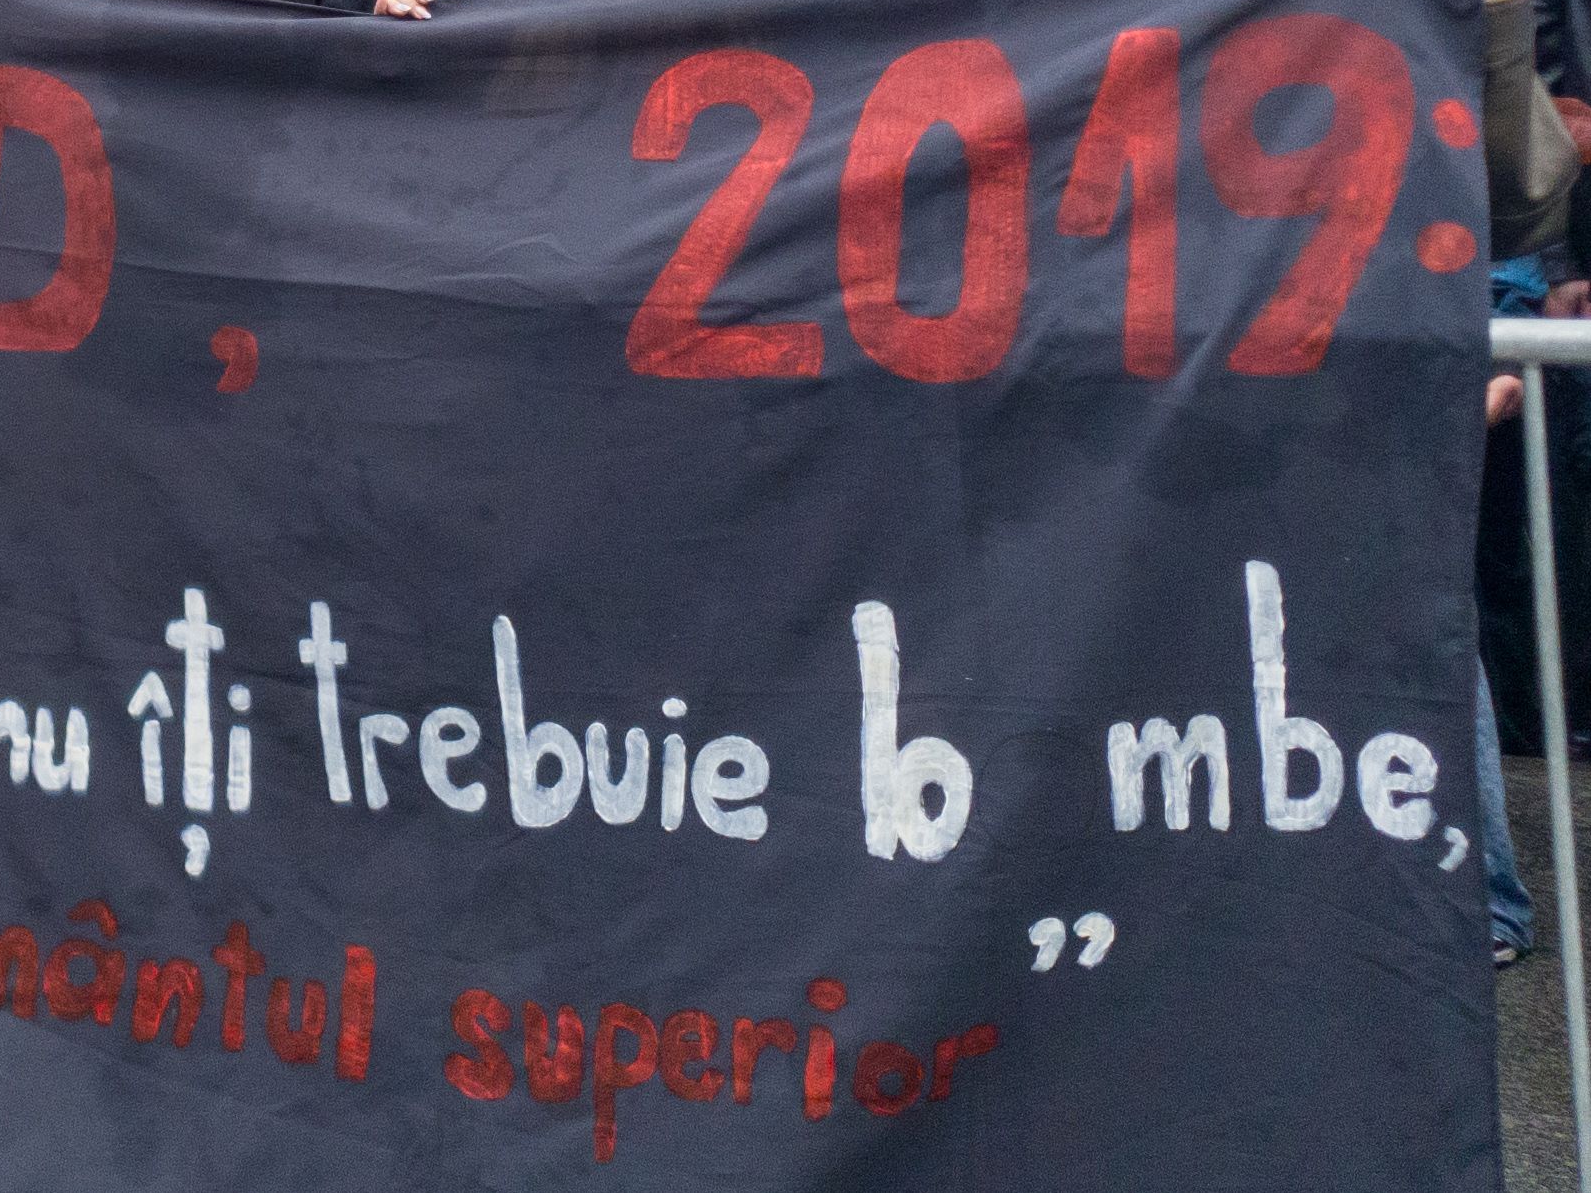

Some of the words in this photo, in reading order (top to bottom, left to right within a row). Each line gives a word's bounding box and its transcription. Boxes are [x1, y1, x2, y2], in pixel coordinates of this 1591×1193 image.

[625, 13, 1478, 384] 2019:
[127, 587, 253, 877] îți
[298, 602, 770, 842] trebuie
[442, 975, 1001, 1165] superior
